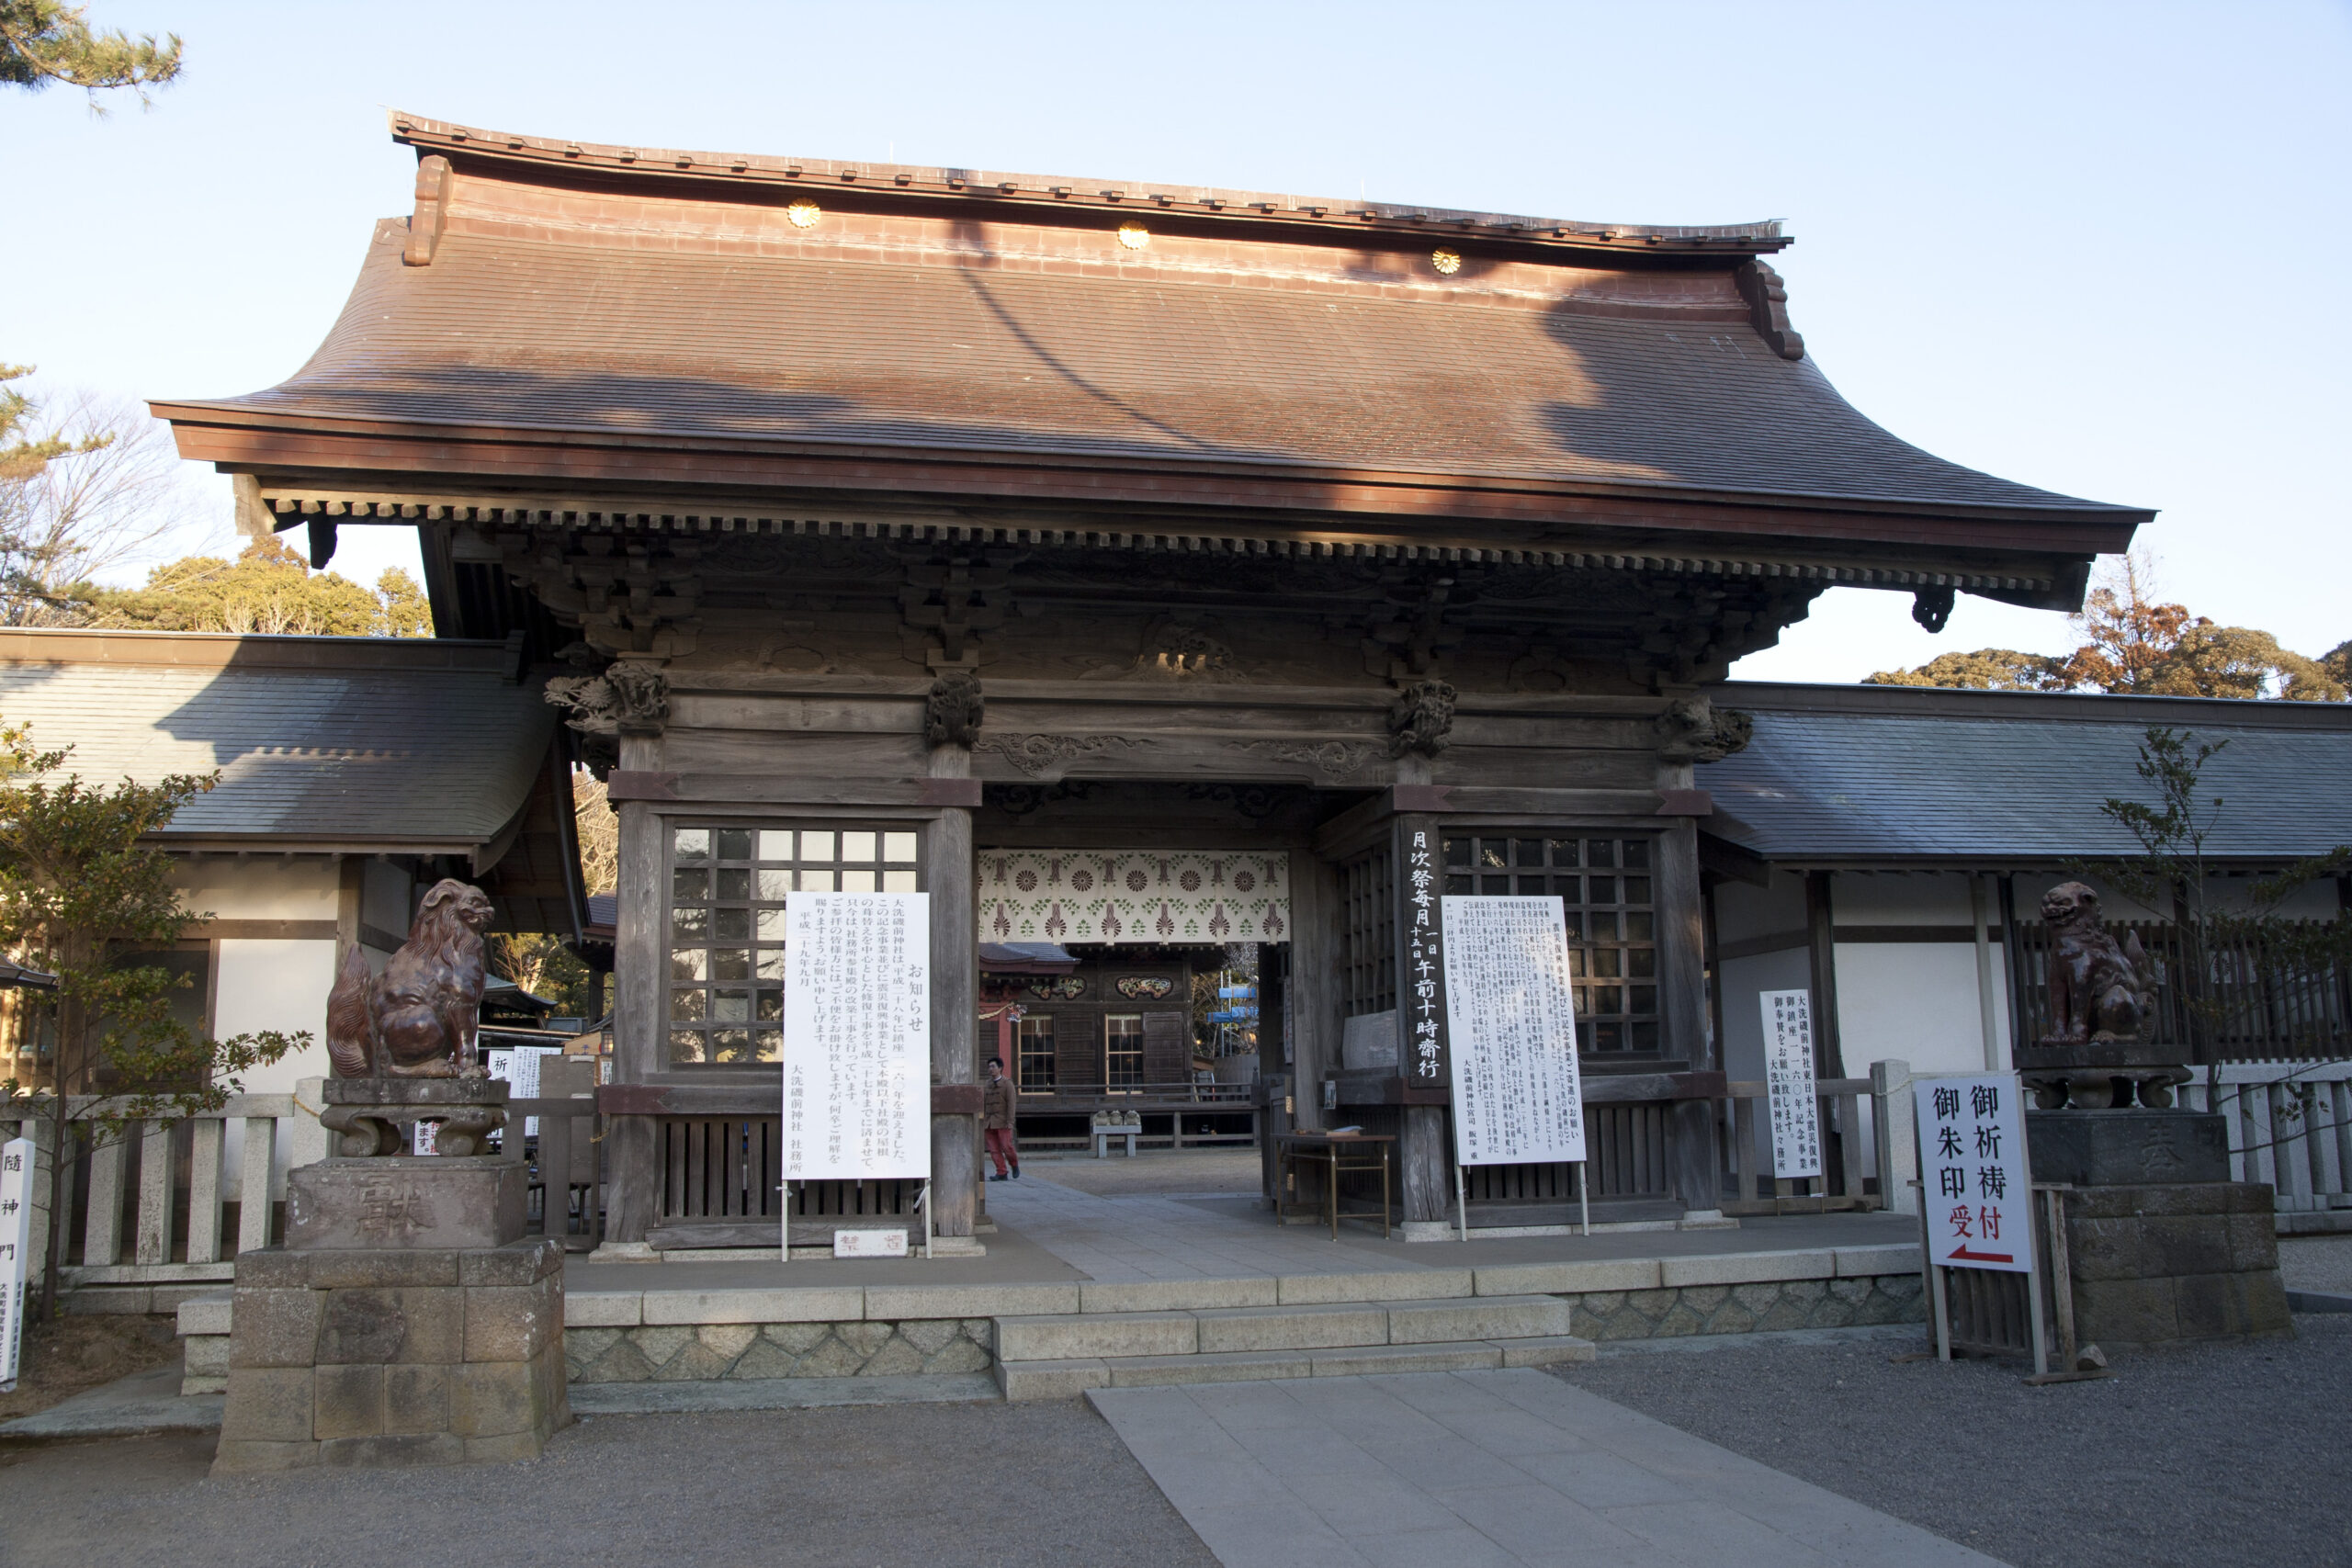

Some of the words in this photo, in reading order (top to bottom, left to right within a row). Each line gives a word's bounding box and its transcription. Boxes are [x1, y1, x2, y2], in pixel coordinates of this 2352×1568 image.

[798, 911, 810, 987] 平成二十九年九月
[1410, 927, 1423, 958] 十五日
[1426, 931, 1438, 954] 一日
[908, 963, 923, 1032] お知らせ
[790, 1065, 803, 1131] 大洗磯前神社
[1770, 1060, 1785, 1170] 大洗磯前神社々務所
[1787, 997, 1807, 1169] 御鎮座一一六〇年記念事業
[1798, 996, 1818, 1168] 大洗磯前神社東日本大震災復興
[788, 1138, 802, 1173] 社務所
[1933, 1087, 1964, 1200] 御朱印
[1970, 1085, 2007, 1200] 御祈祷
[1950, 1204, 2002, 1240] 受付
